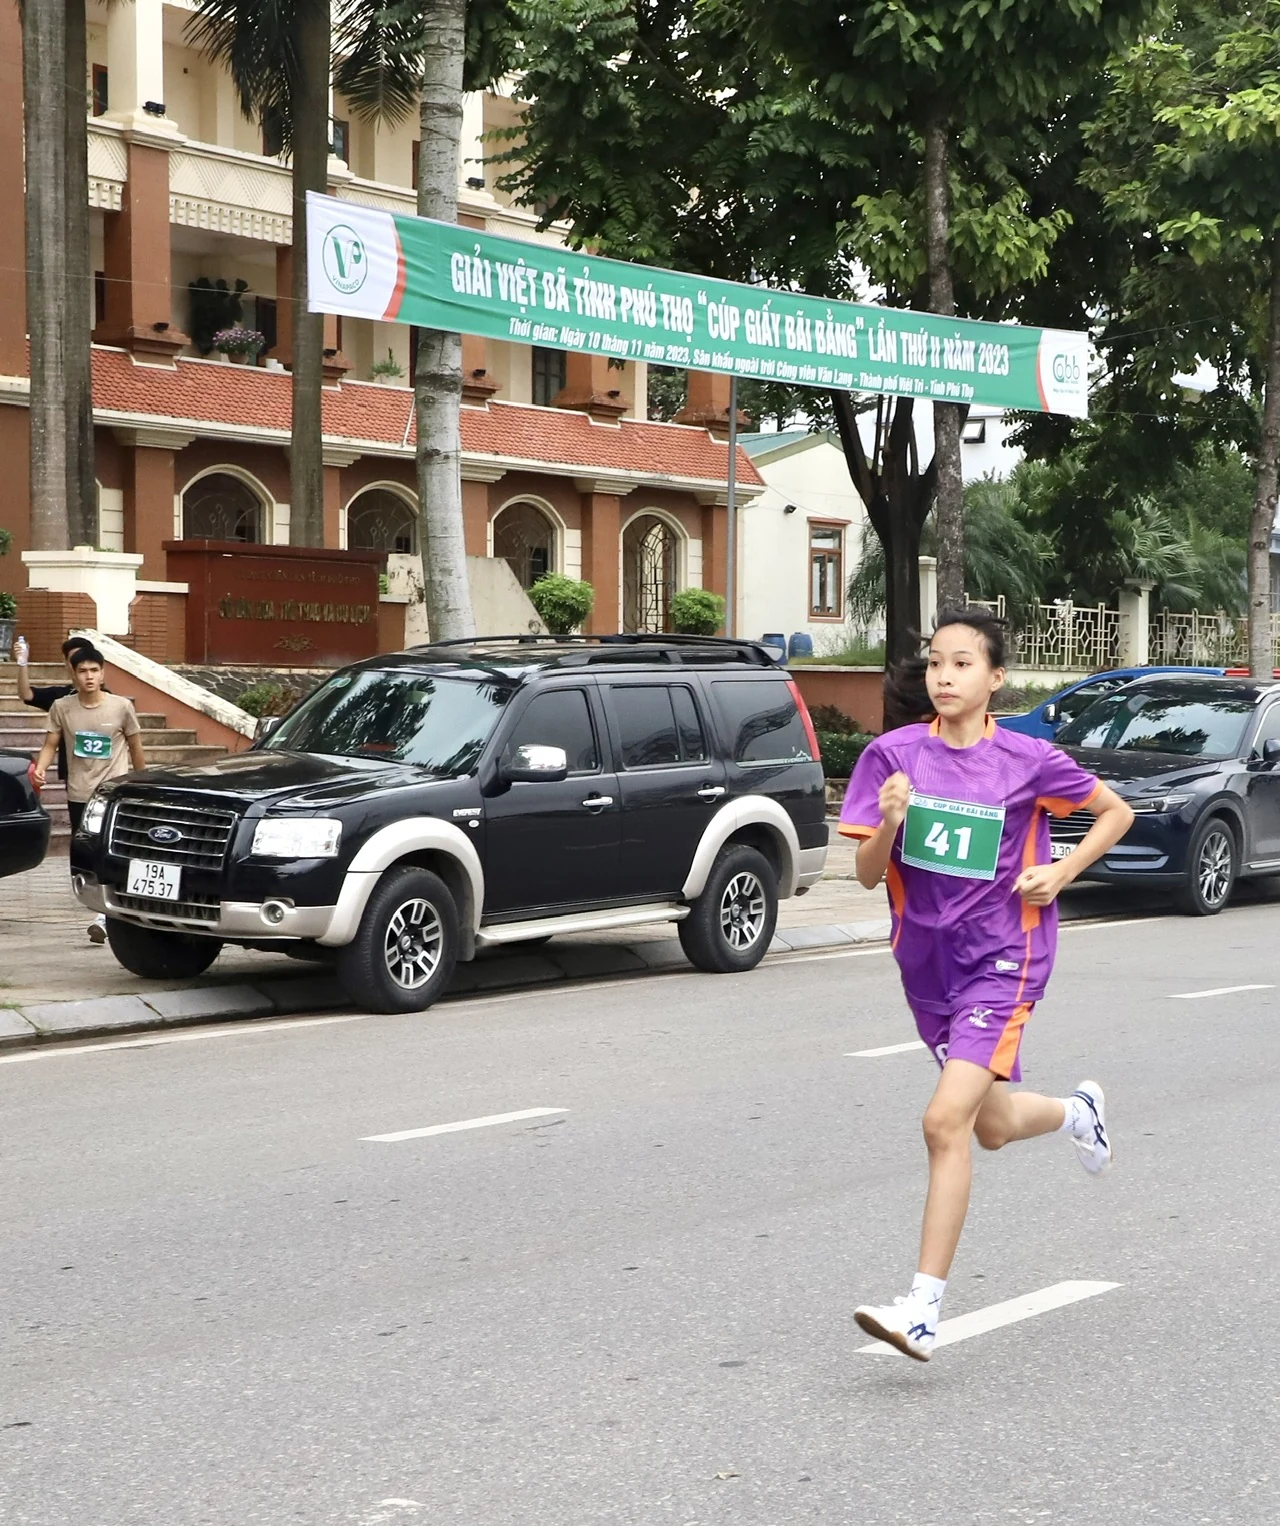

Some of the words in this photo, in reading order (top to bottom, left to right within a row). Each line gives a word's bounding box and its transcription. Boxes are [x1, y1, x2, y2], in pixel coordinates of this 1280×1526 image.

[450, 243, 493, 299] GIẢI
[495, 257, 538, 314] VIỆT
[572, 266, 617, 322] TỈNH
[619, 283, 657, 329] PHÚ
[659, 293, 694, 343] THỌ
[744, 299, 781, 348] GIẤY
[784, 310, 813, 353] BÃI
[867, 317, 898, 364] LẦN
[899, 327, 929, 368] THỨ
[930, 335, 941, 369] II
[943, 332, 976, 373] NĂM
[977, 342, 1009, 377] 2023
[509, 317, 533, 338] Thời
[532, 322, 559, 342] gian:
[560, 326, 587, 349] Ngày
[588, 331, 601, 349] 10
[601, 333, 629, 356] tháng
[631, 339, 643, 356] 11
[643, 341, 665, 360] năm
[665, 344, 691, 365] 2023,
[692, 348, 711, 367] Sân
[711, 350, 734, 370] khấu
[734, 356, 760, 374] ngoài
[760, 359, 776, 376] trời
[776, 361, 798, 380] Công
[798, 364, 816, 382] viên
[818, 366, 833, 383] Văn
[834, 368, 854, 387] Lang
[859, 371, 883, 389] Thành
[883, 374, 899, 392] phố
[899, 376, 913, 395] Việt
[945, 382, 961, 397] Phú
[961, 383, 975, 401] Thọ
[83, 739, 103, 753] 32
[154, 828, 173, 839] Ford
[923, 821, 973, 861] 41
[145, 864, 165, 880] 19A
[132, 878, 174, 898] 475.37
